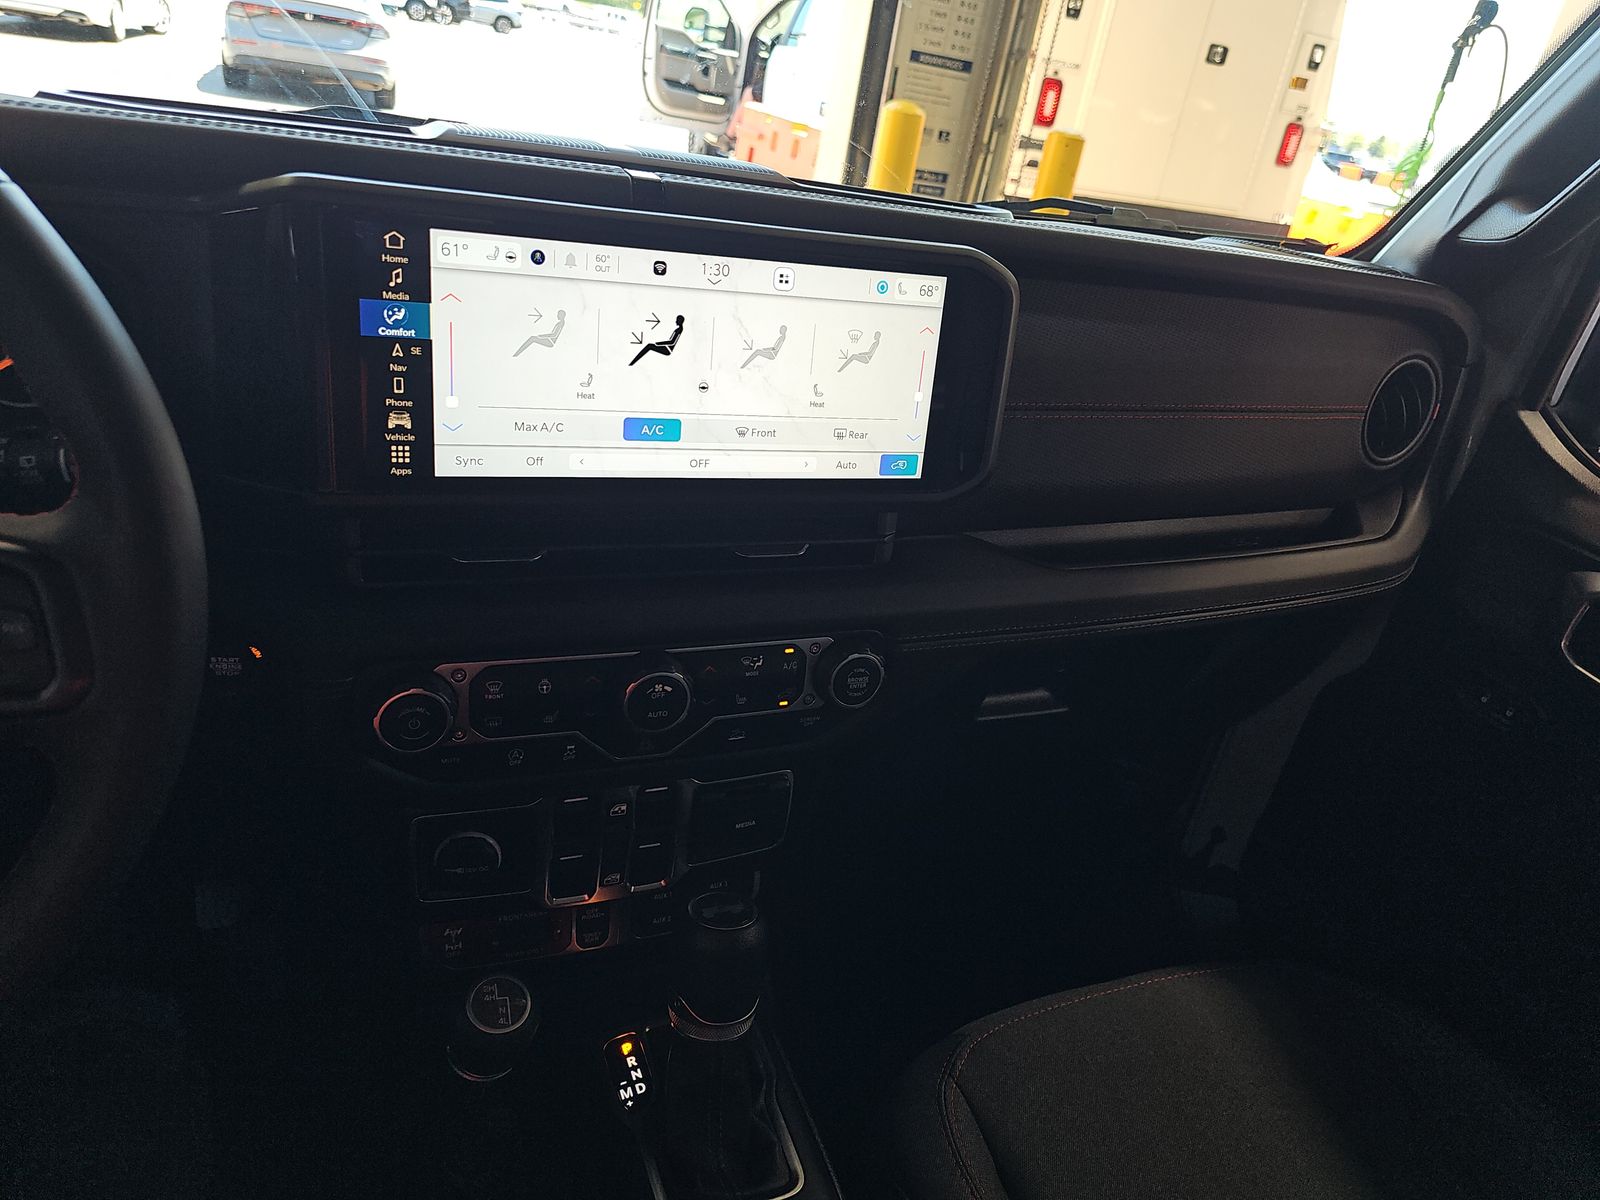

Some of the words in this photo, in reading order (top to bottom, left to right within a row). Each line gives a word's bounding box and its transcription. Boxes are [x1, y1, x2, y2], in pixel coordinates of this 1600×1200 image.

[441, 242, 469, 258] 61°
[381, 254, 409, 265] Home
[595, 254, 611, 263] 60°
[595, 264, 611, 273] OUT
[701, 263, 730, 277] 1:30
[382, 290, 410, 302] Media
[919, 284, 940, 298] 68°
[378, 326, 416, 338] Comfort
[410, 346, 422, 356] SE
[390, 363, 407, 372] Nav
[576, 391, 595, 400] Heat
[386, 398, 413, 407] Phone
[809, 400, 825, 409] Heat
[514, 422, 538, 433] Max
[539, 422, 564, 434] A/C
[641, 424, 664, 436] A/C
[751, 428, 777, 438] Front
[385, 432, 415, 442] Vehicle
[848, 430, 868, 440] Rear
[454, 455, 484, 468] Sync
[526, 456, 544, 467] Off
[689, 459, 710, 469] OFF
[836, 460, 857, 471] Auto
[390, 466, 412, 476] Apps
[783, 661, 798, 671] A/C
[647, 710, 668, 718] AUTO
[621, 1042, 632, 1055] P
[626, 1055, 638, 1068] R
[630, 1068, 643, 1081] N
[619, 1086, 634, 1100] M
[634, 1082, 646, 1095] D
